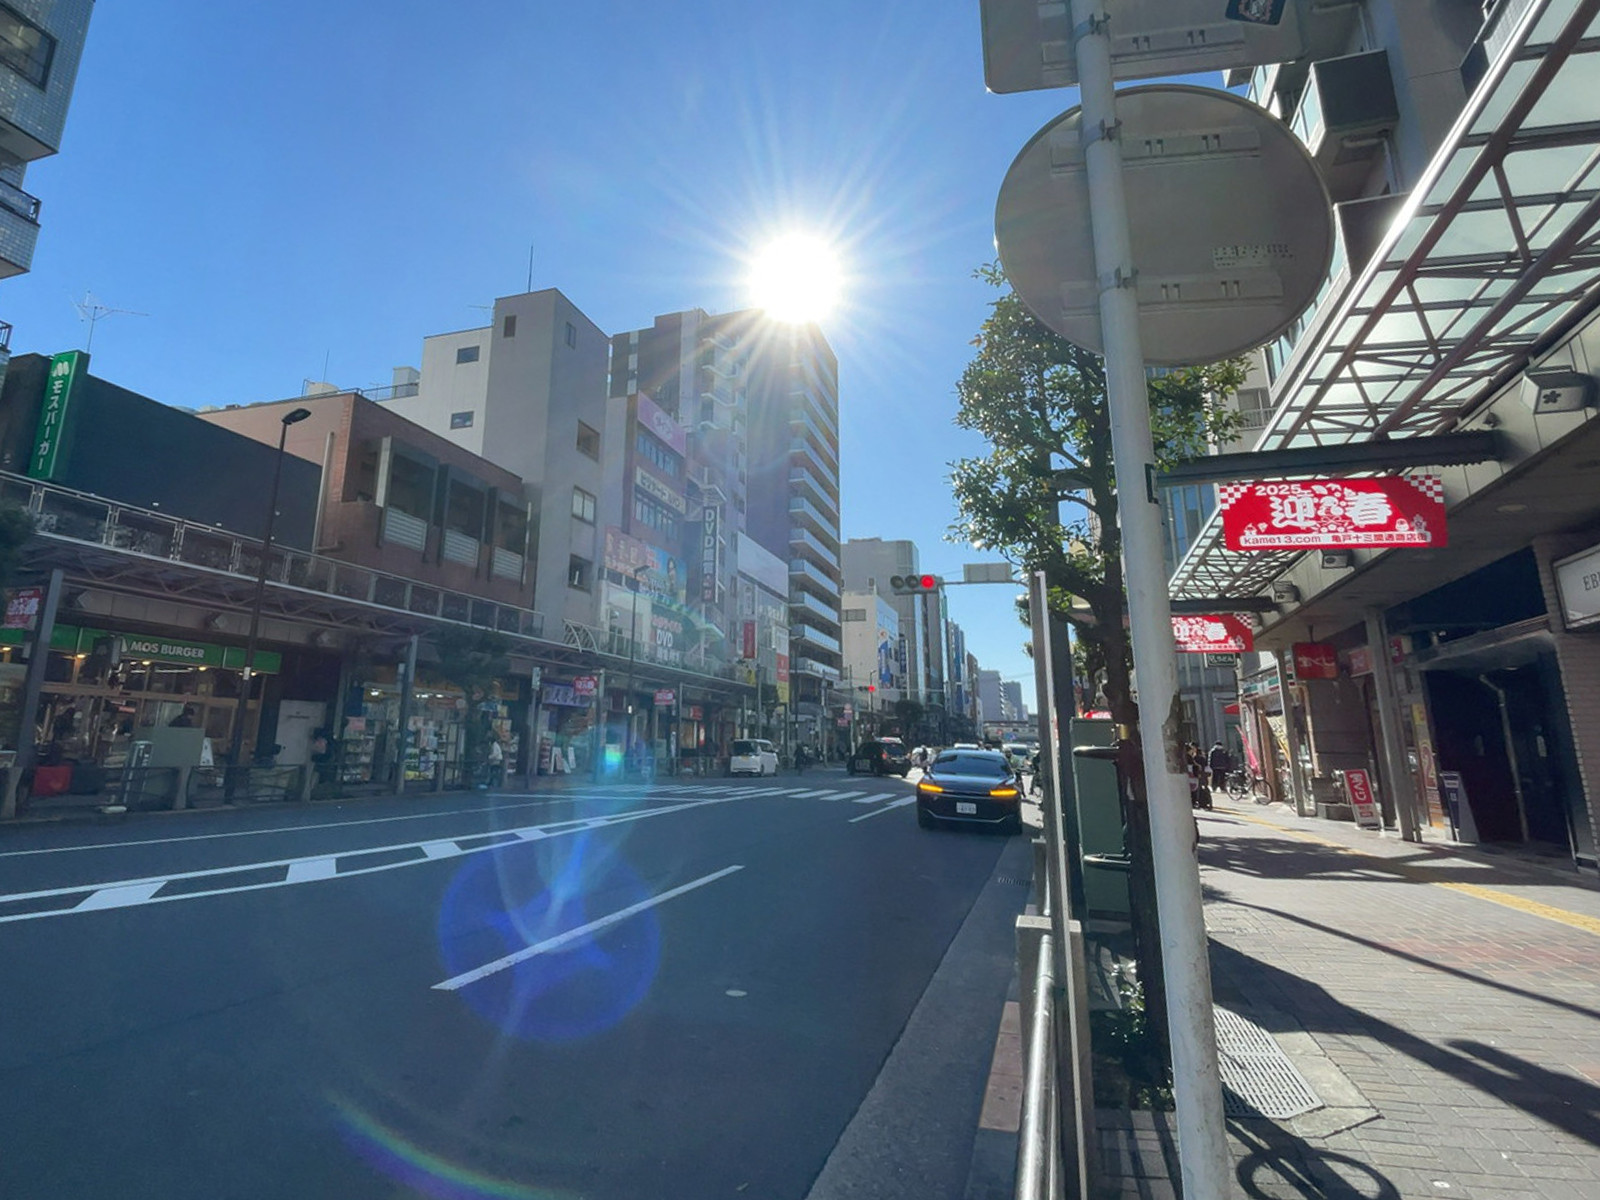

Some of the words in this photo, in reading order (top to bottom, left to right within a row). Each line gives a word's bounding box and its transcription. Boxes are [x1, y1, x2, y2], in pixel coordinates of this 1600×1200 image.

[38, 380, 64, 471] モスバーガー
[1255, 484, 1301, 496] 2025
[1270, 491, 1392, 528] 迎春
[1243, 535, 1321, 545] kame13.com
[1331, 533, 1428, 544] 亀戸十三間通商店街
[656, 629, 674, 648] DVD
[130, 640, 160, 654] MOS
[160, 644, 205, 659] BURGER
